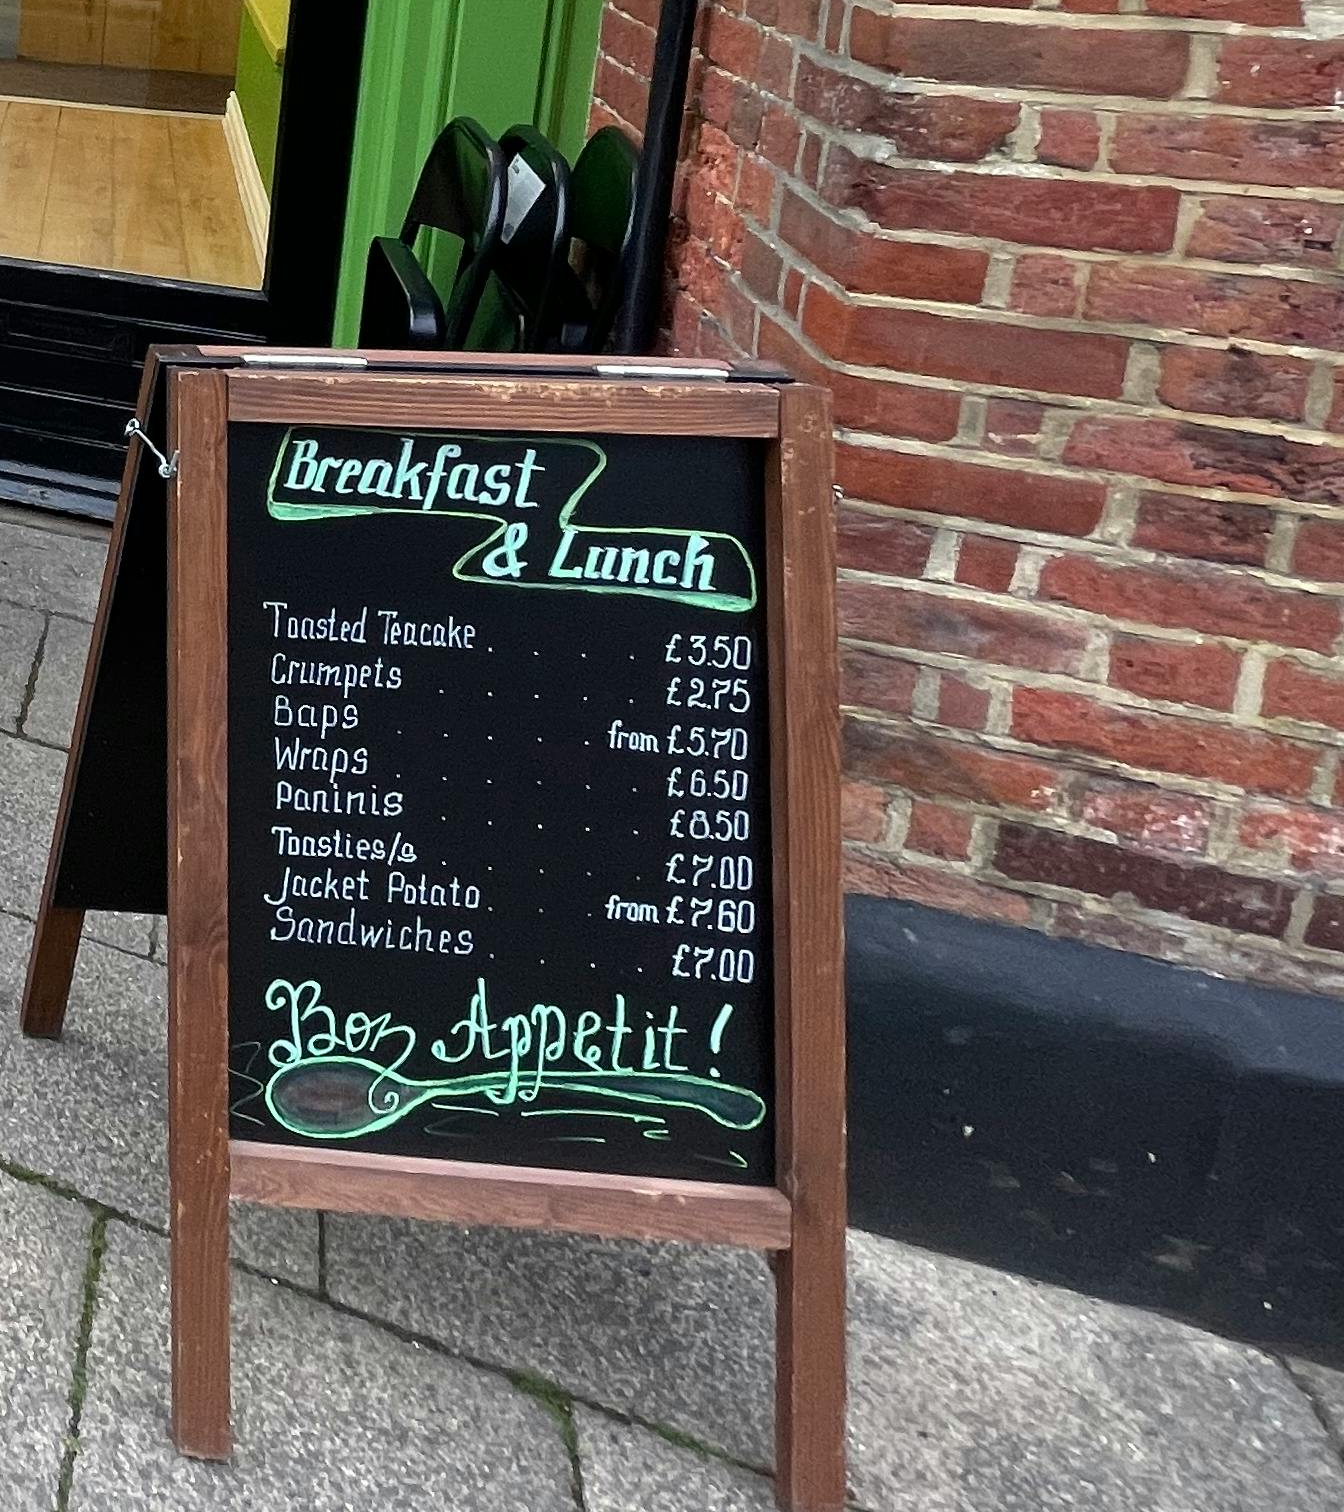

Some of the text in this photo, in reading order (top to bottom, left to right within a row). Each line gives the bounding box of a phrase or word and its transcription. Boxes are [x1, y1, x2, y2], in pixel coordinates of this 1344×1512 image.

[284, 438, 546, 510] Breakfast
[482, 522, 716, 591] & Lunch
[263, 601, 752, 670] Toasted Teacake £3.50
[270, 652, 751, 713] Crumpets £2.75
[274, 694, 749, 761] Baps from £5.70
[274, 736, 749, 801] Wraps £6.50
[275, 780, 750, 842] Paninis £8.50
[263, 866, 756, 934] Jacket Potato from £7.60
[665, 852, 754, 891] £7.00
[270, 905, 755, 984] Sandwiches £7.00
[265, 978, 416, 1115] Bon
